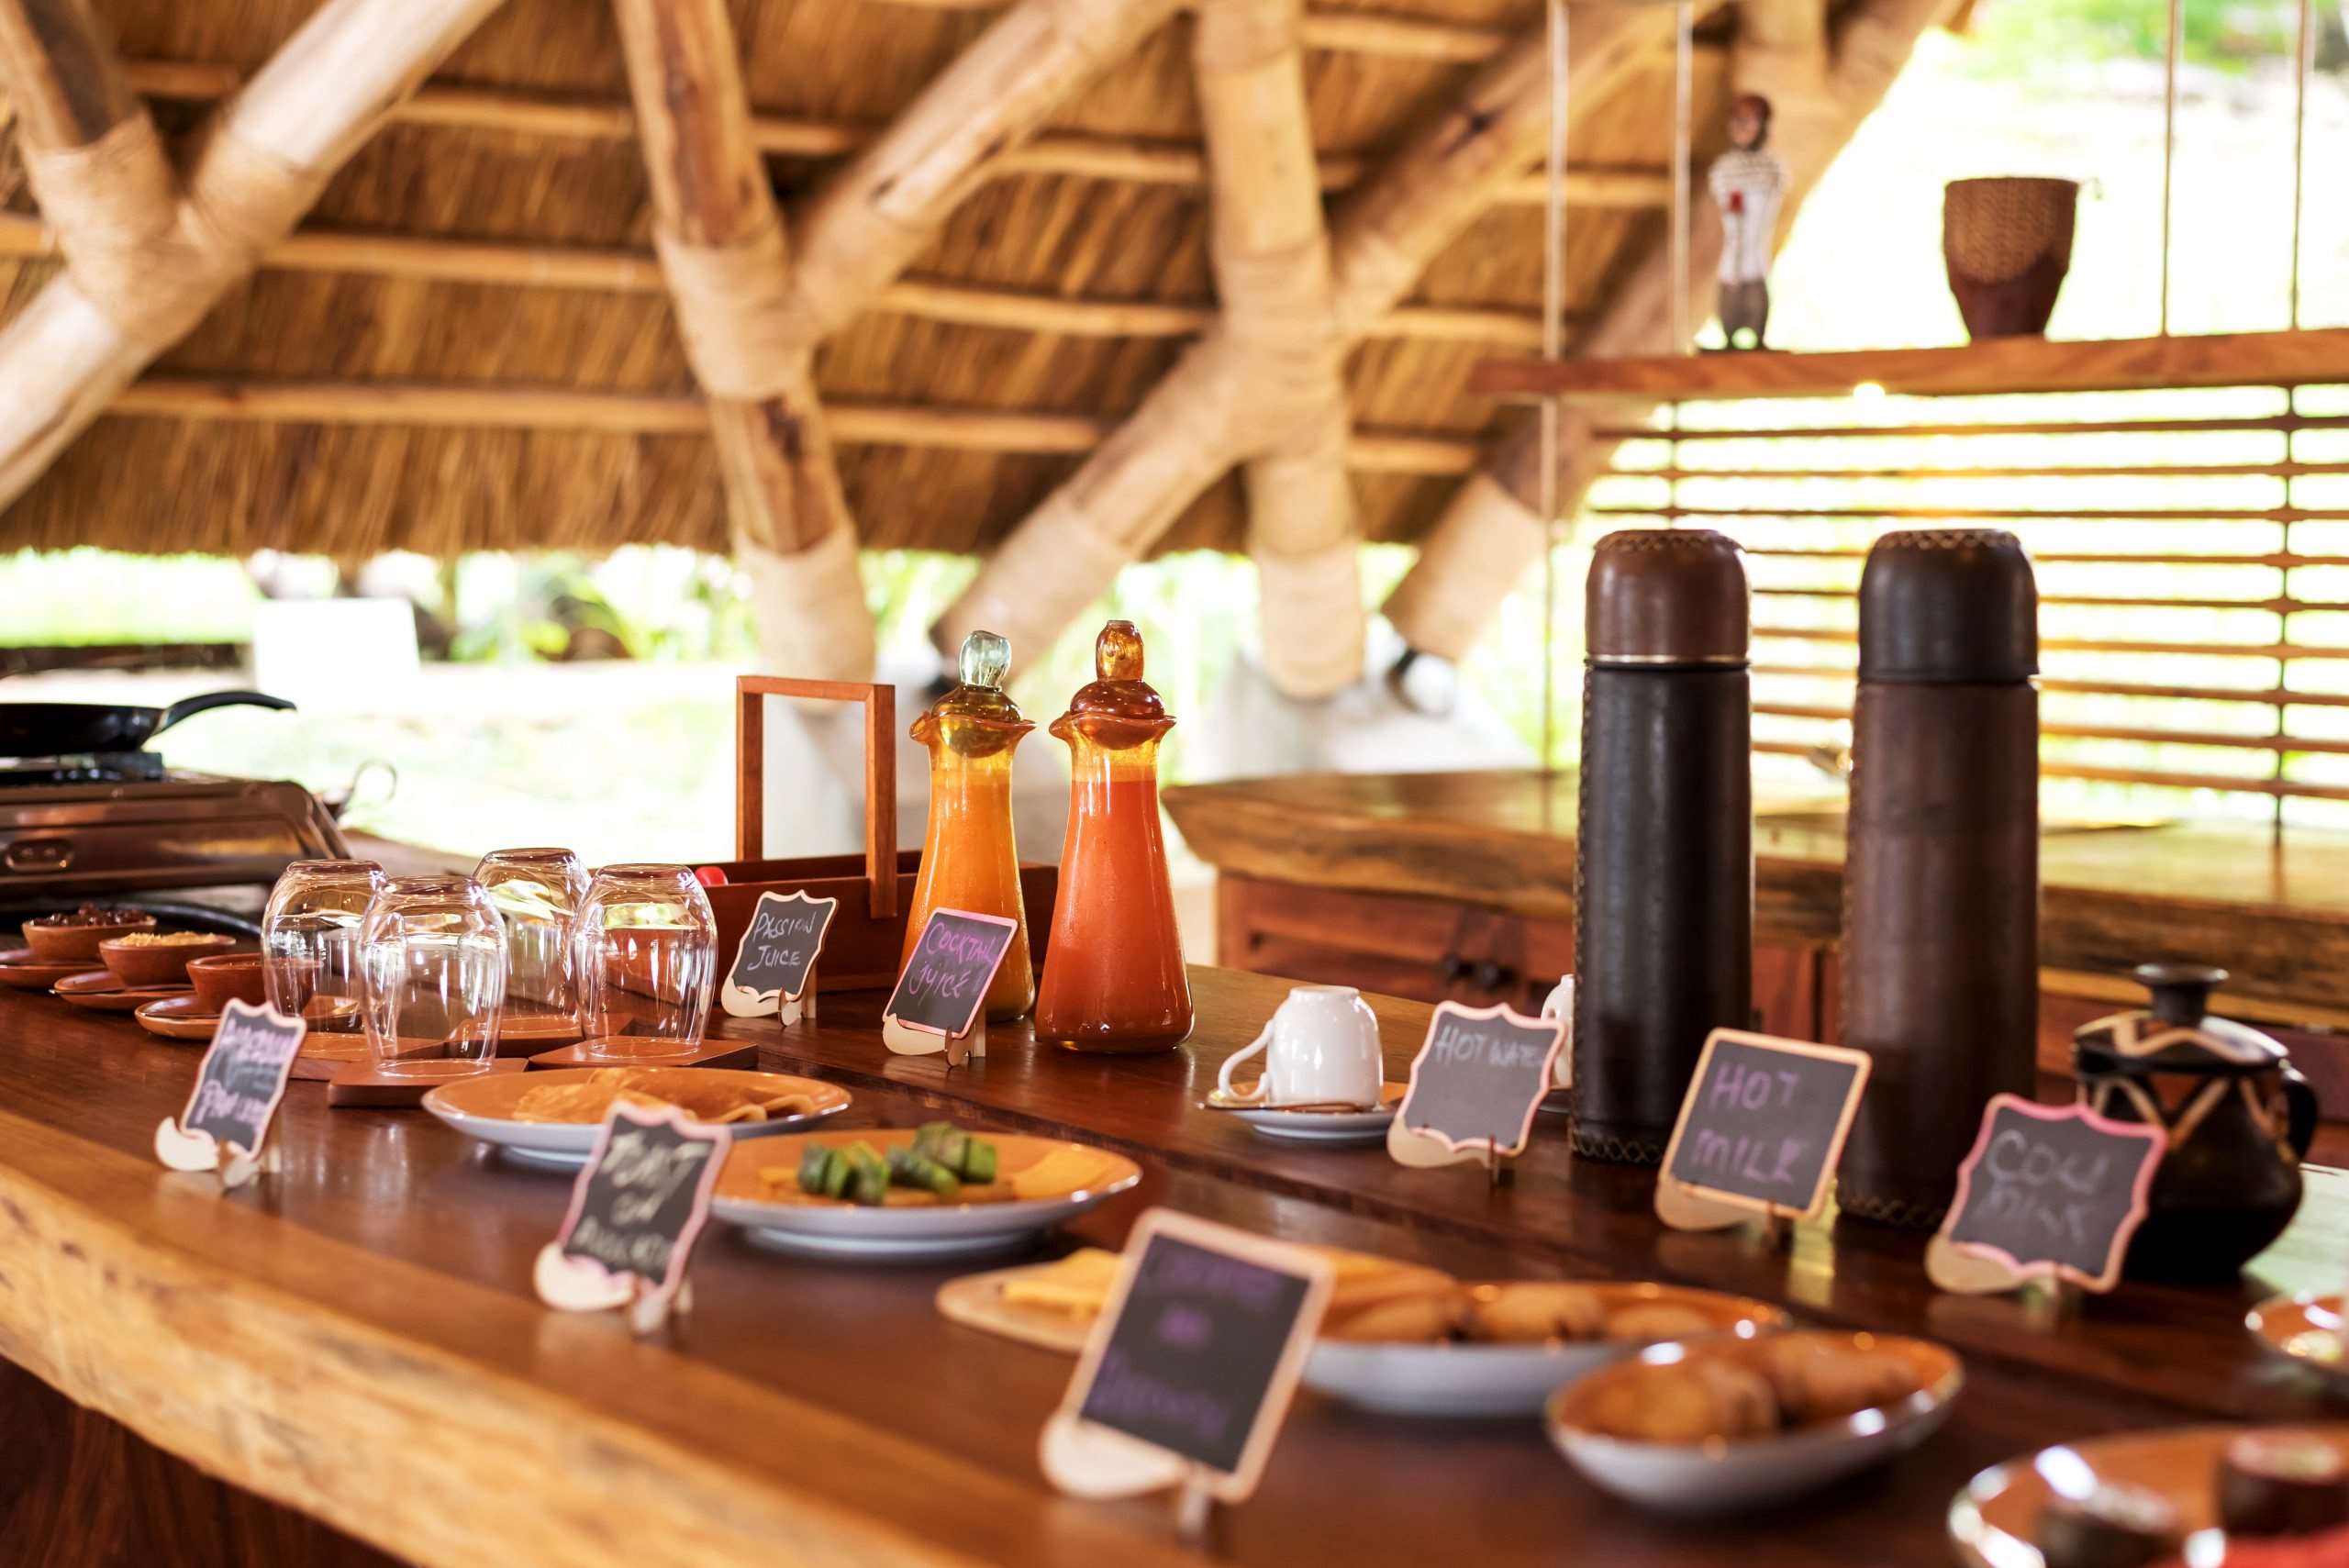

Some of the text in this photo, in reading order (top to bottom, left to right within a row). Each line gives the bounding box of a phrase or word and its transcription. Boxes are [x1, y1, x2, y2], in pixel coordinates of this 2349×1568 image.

[752, 912, 817, 942] PASSION
[747, 945, 801, 971] JUICE
[1434, 1024, 1486, 1065] HOT
[1709, 1062, 1799, 1110] HOT
